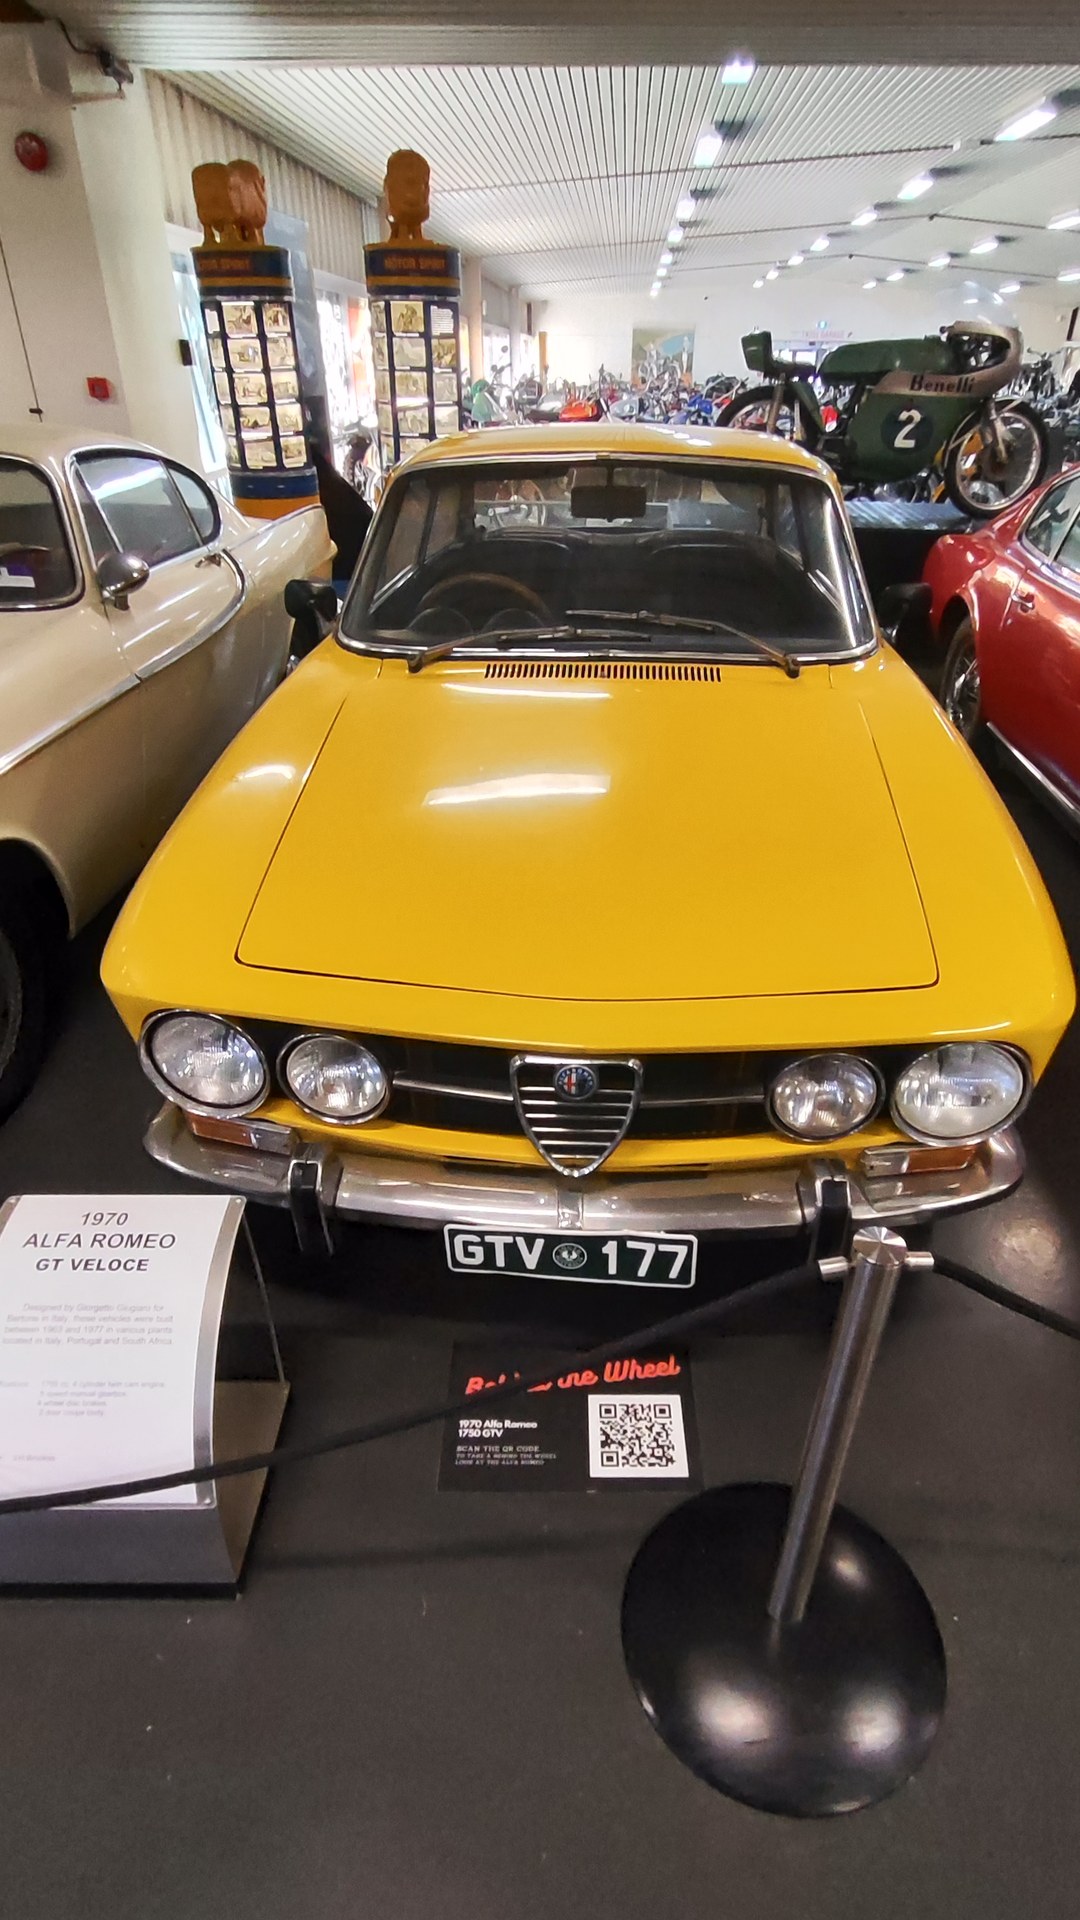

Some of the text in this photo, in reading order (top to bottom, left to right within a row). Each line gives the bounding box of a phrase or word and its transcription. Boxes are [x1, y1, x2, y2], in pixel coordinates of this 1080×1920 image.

[910, 374, 975, 393] Benelli
[894, 409, 921, 448] 2
[80, 1212, 129, 1226] 1970
[22, 1233, 176, 1249] ALFA ROMEO
[453, 1234, 545, 1270] GTV
[601, 1240, 689, 1279] 177
[35, 1258, 150, 1272] GT VELOCE
[65, 1326, 81, 1335] and
[104, 1336, 119, 1346] and
[122, 1336, 146, 1346] South
[603, 1354, 681, 1383] Wheel
[459, 1419, 538, 1429] 1970 Alfa Romeo
[458, 1429, 503, 1438] 1750 GTV
